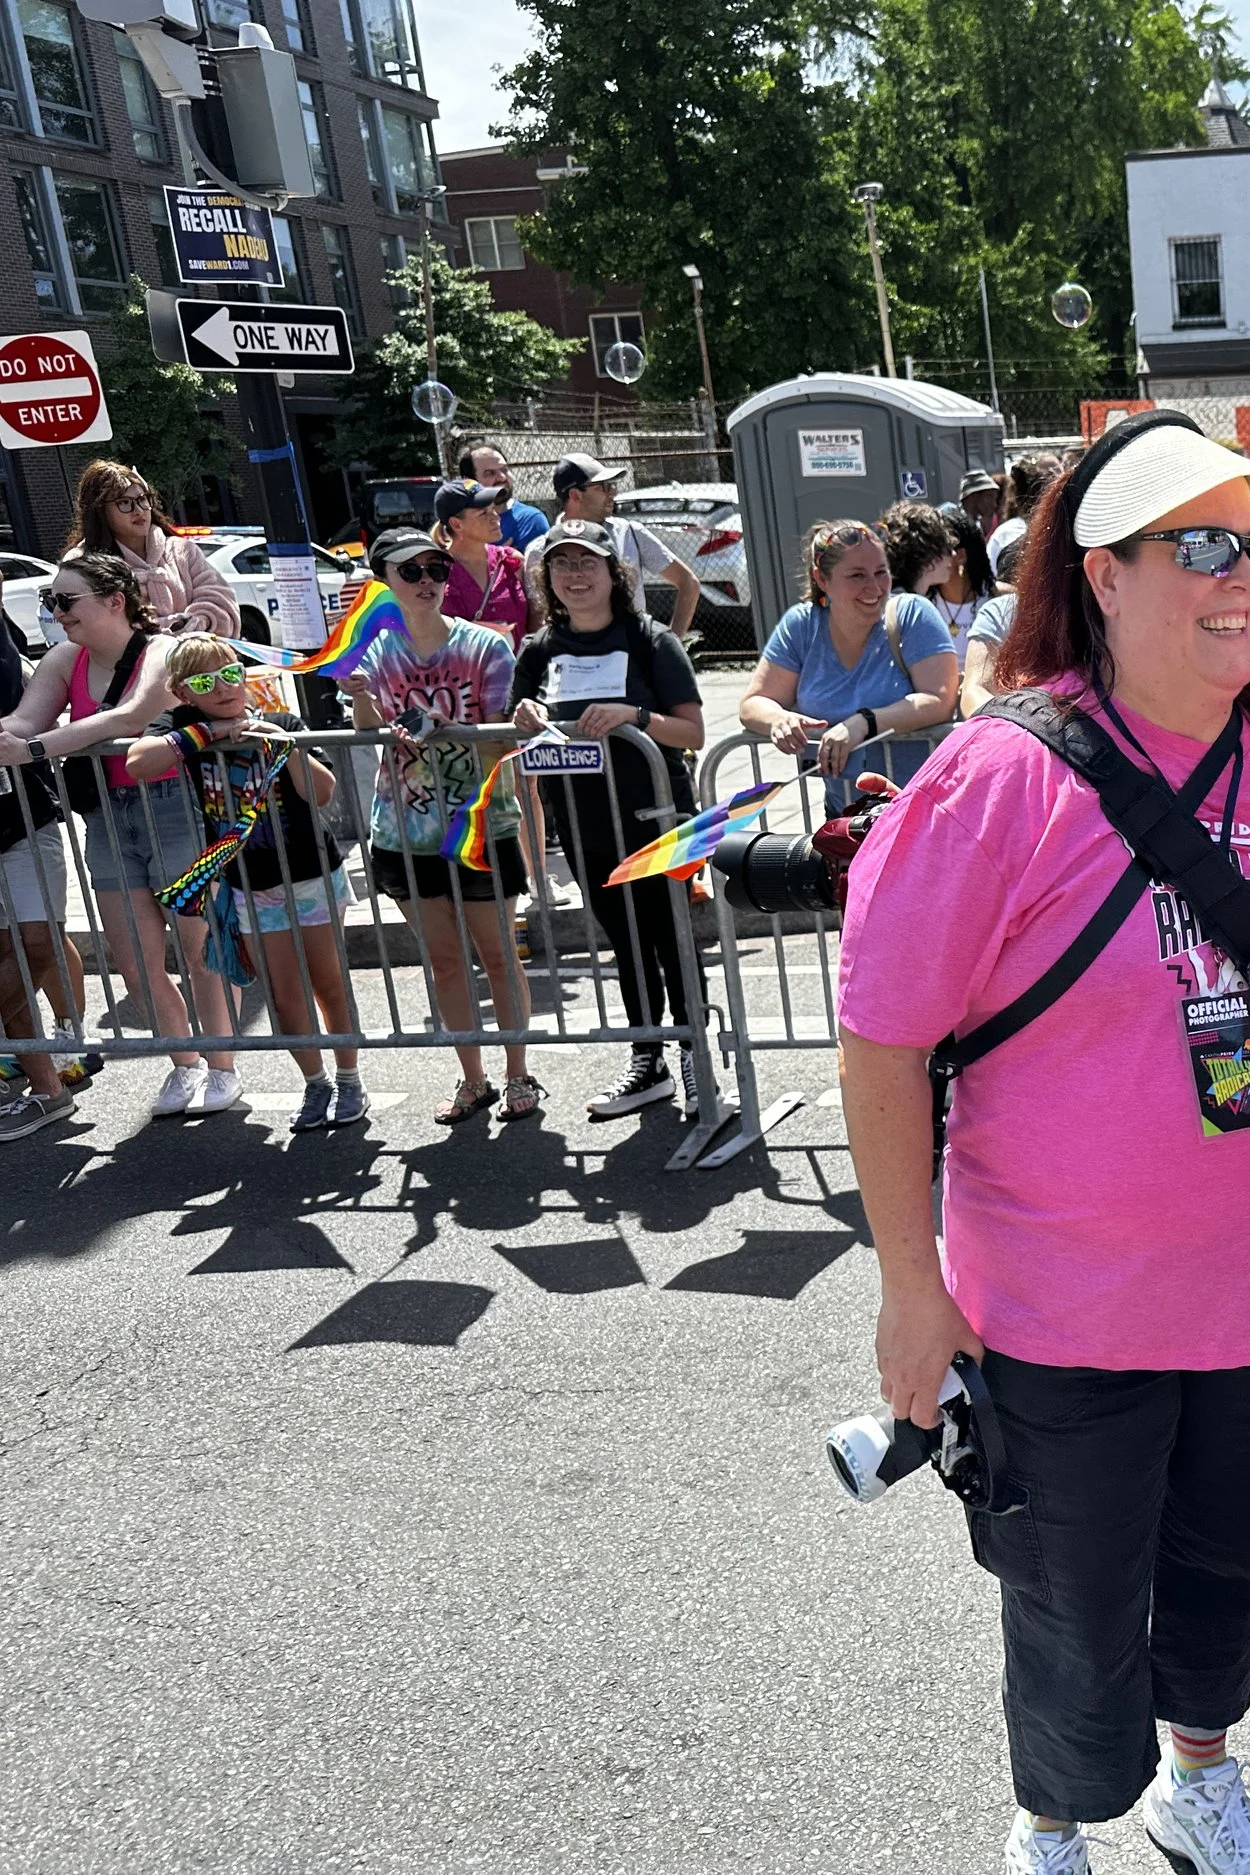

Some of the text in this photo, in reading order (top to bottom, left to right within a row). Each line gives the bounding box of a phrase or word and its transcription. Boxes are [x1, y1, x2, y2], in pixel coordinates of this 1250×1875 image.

[192, 196, 206, 207] THE
[178, 207, 247, 234] RECALL
[233, 324, 330, 352] ONE WAY
[1, 354, 76, 377] DO NOT
[18, 404, 83, 426] ENTER
[802, 434, 860, 446] WALTERS
[525, 746, 598, 768] LONG FENCE
[1187, 997, 1247, 1018] OFFICIAL
[1188, 1010, 1249, 1026] PHOTOGRAPHER
